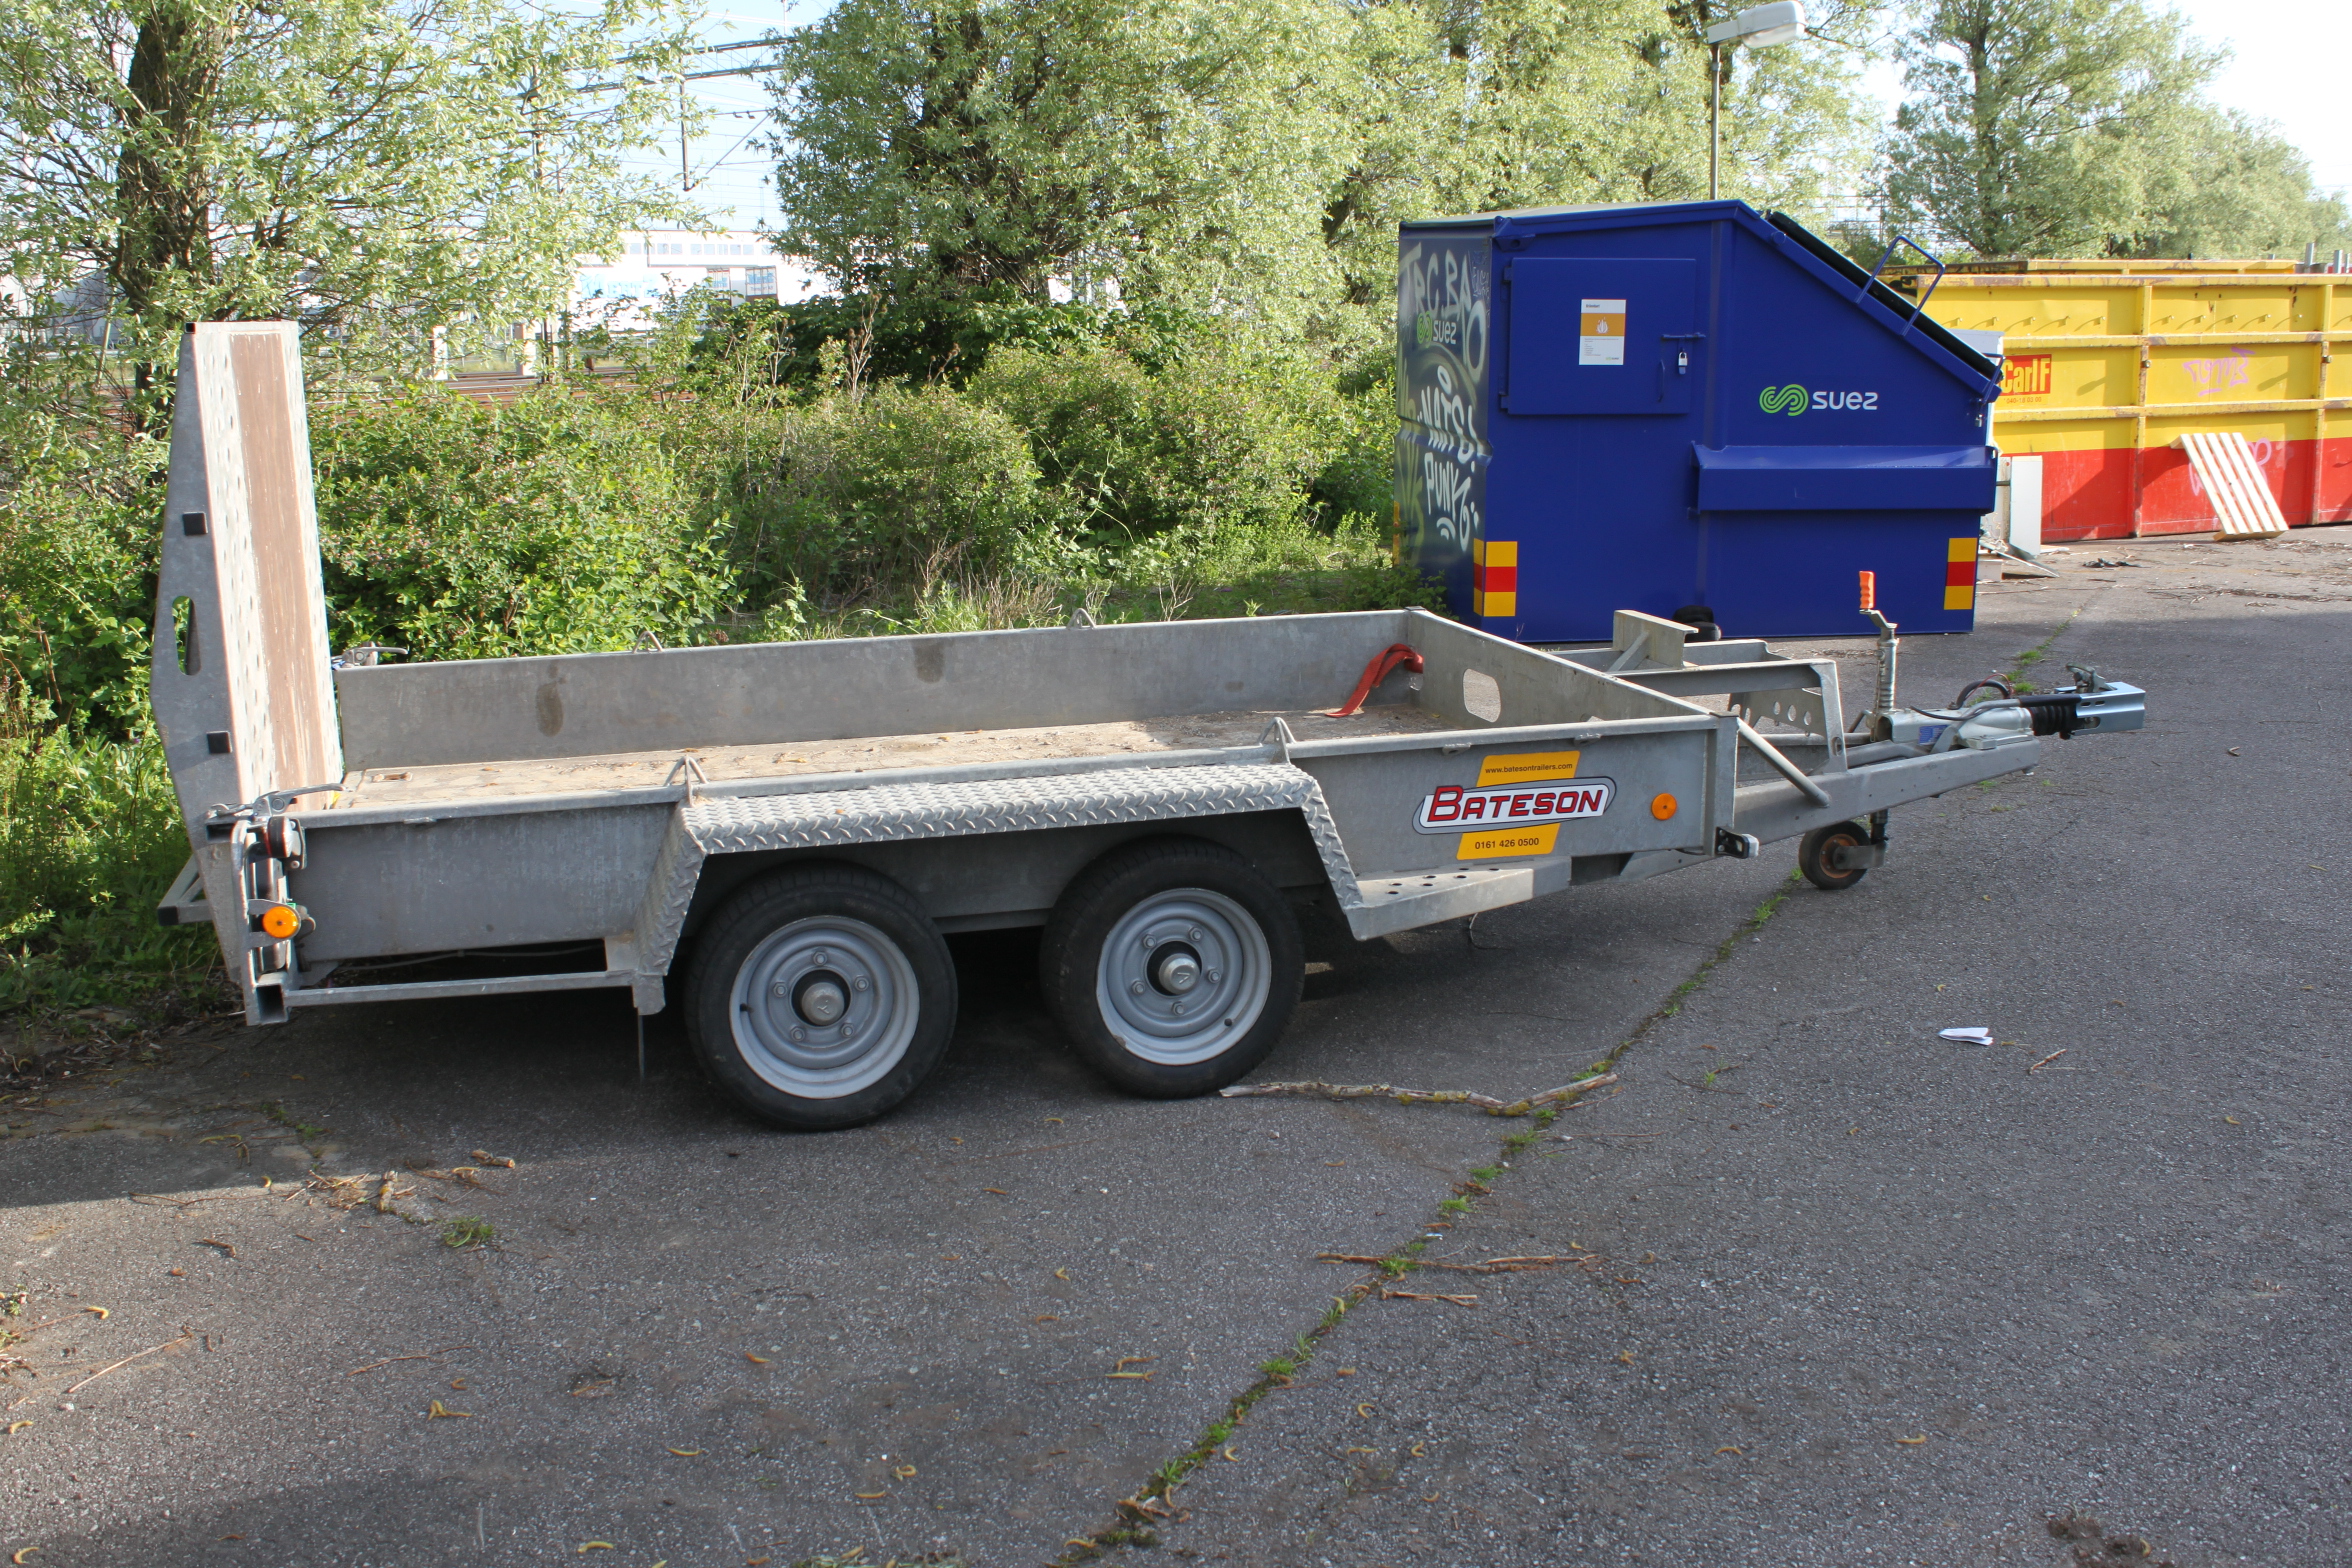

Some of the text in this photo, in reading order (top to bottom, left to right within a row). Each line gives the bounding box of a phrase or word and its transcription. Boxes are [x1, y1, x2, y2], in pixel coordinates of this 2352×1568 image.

[2001, 357, 2050, 394] Carl F
[1811, 391, 1878, 410] suez
[1485, 763, 1573, 774] www.batesontrailers.com
[1427, 785, 1603, 822] BATESON
[1474, 837, 1540, 849] 0161 426 0500
